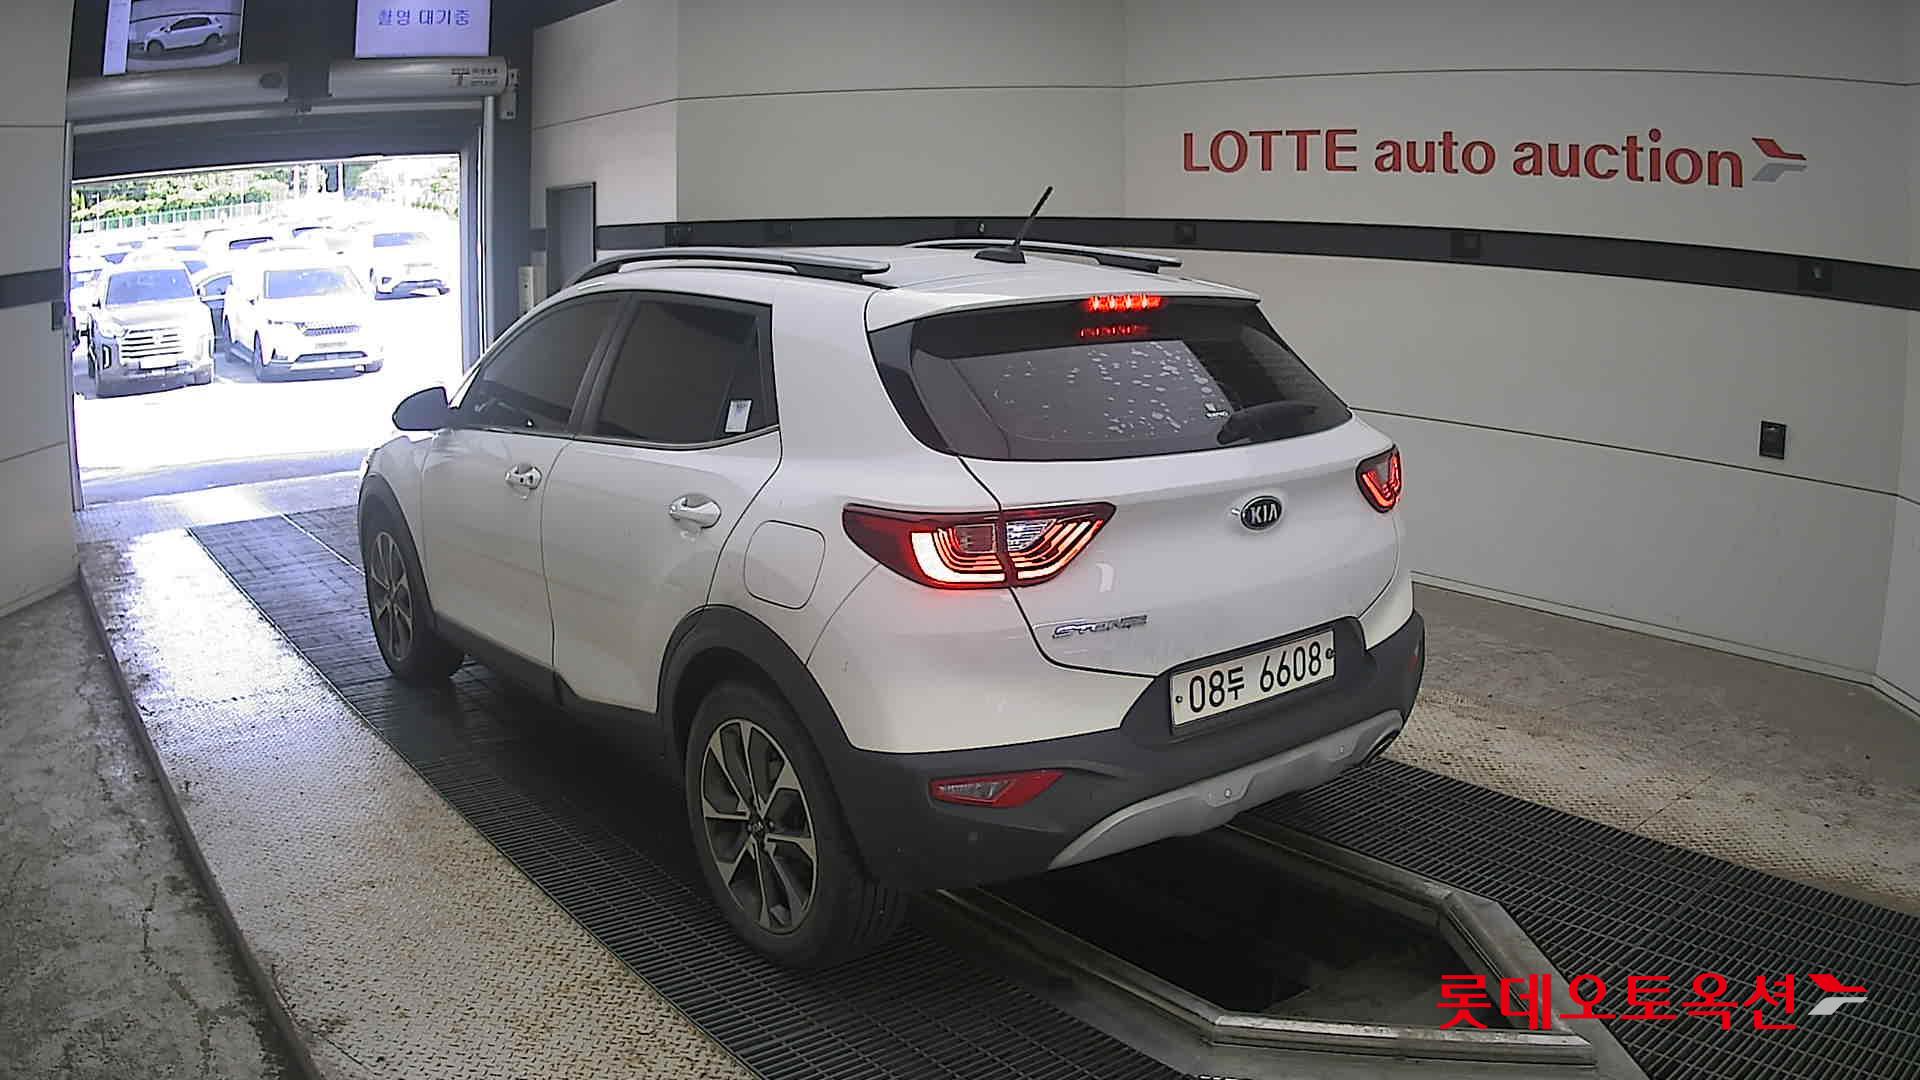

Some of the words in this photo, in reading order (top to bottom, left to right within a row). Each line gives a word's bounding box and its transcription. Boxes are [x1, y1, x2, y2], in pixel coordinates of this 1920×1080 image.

[419, 8, 471, 26] 대기중
[1183, 129, 1358, 173] LOTTE
[1374, 130, 1496, 175] auto
[1512, 128, 1743, 188] auction
[1250, 503, 1278, 524] KIA
[1188, 666, 1245, 713] 08두
[1259, 641, 1322, 693] 6608
